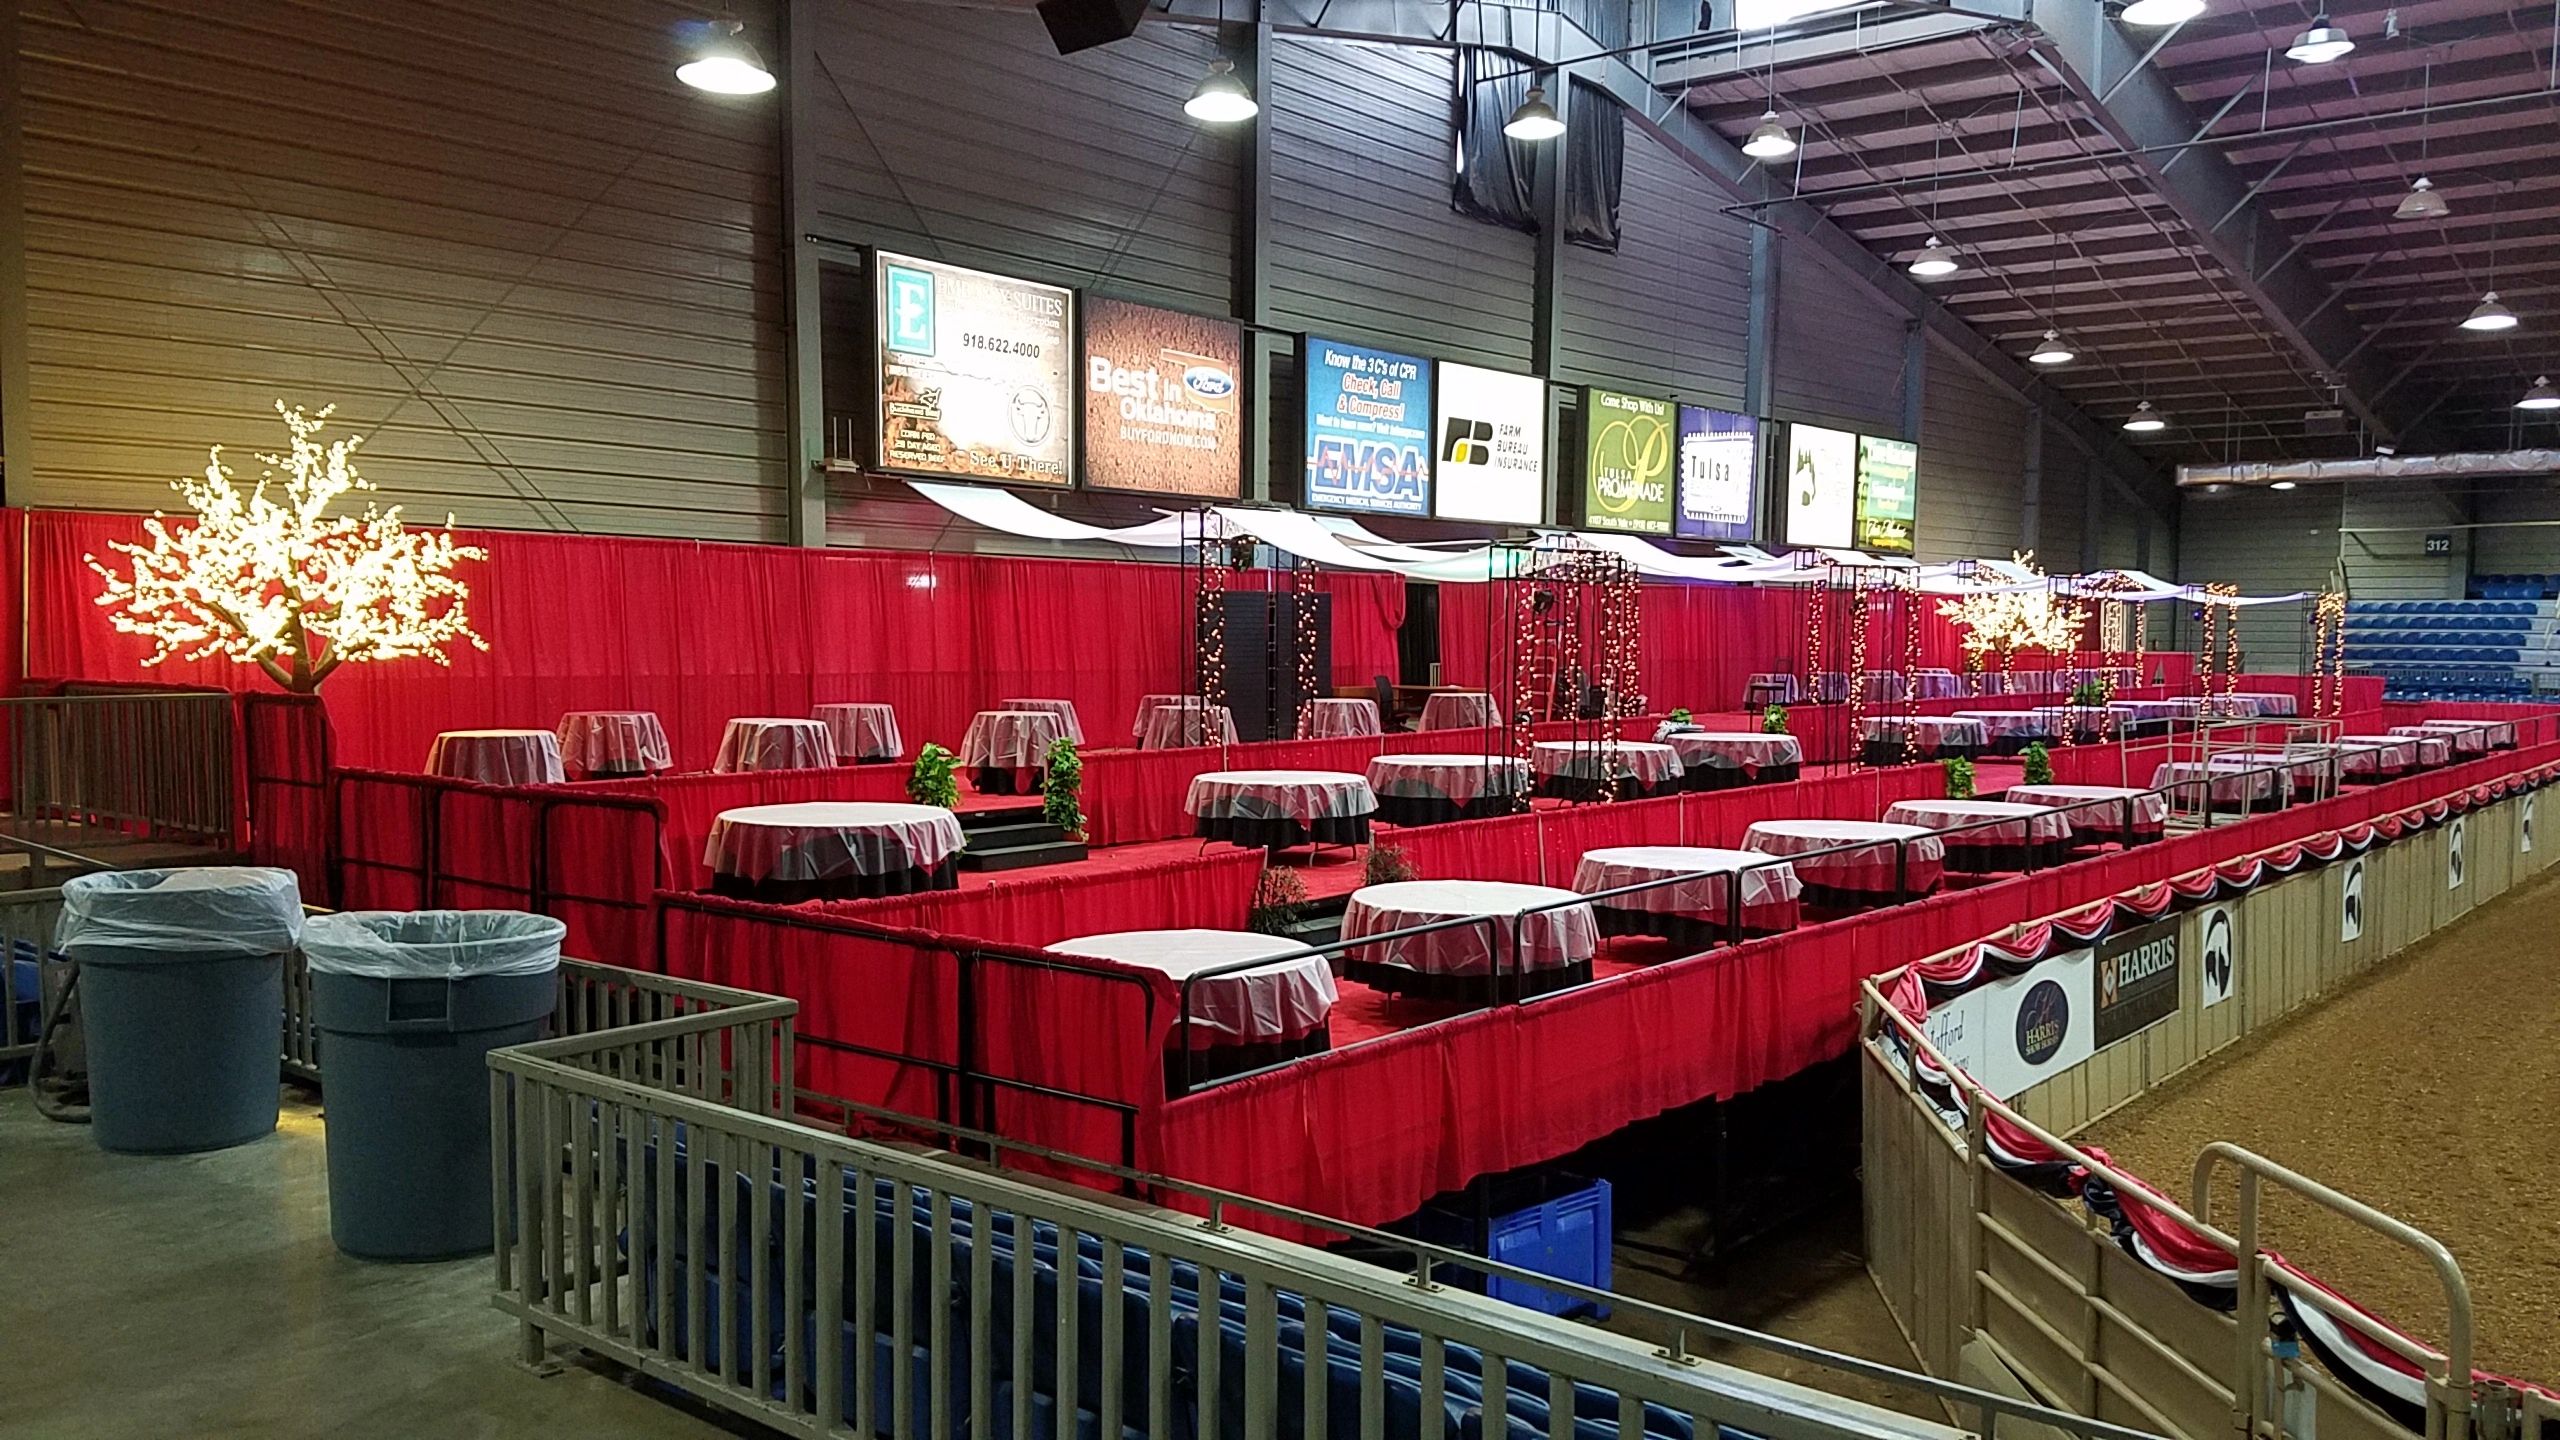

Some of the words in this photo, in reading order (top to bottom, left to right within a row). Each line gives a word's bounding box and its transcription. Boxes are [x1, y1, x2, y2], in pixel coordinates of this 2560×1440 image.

[1014, 292, 1063, 316] SUITES
[963, 333, 1040, 358] 918.622.4000
[1325, 349, 1350, 368] Know
[1352, 355, 1367, 372] the
[1389, 362, 1399, 377] of
[1400, 363, 1417, 380] CPR
[1090, 355, 1159, 401] Best
[1192, 372, 1225, 394] Ford
[1343, 373, 1378, 398] Check,
[1380, 379, 1401, 399] Call
[1119, 397, 1217, 431] Oklahoma
[1337, 394, 1347, 413] &
[1349, 395, 1405, 421] Compress!
[1601, 393, 1620, 408] Come
[1621, 396, 1638, 413] Shop
[1639, 400, 1654, 414] With
[1119, 425, 1217, 450] BUYFORDNOW.COM
[1500, 424, 1521, 437] FARM
[1497, 440, 1528, 455] BUREAU
[970, 450, 995, 467] See
[1000, 453, 1012, 469] U
[1017, 454, 1063, 475] There!
[1314, 438, 1421, 498] EMSA
[1495, 456, 1538, 472] INSURANCE
[1604, 467, 1632, 480] TULSA
[1692, 456, 1729, 481] Tulsa
[1598, 476, 1665, 502] PROMENADE
[2427, 540, 2449, 551] 312
[2118, 935, 2176, 988] HARRIS
[1926, 1009, 1965, 1057] tafford
[2026, 1020, 2060, 1046] HARRIS
